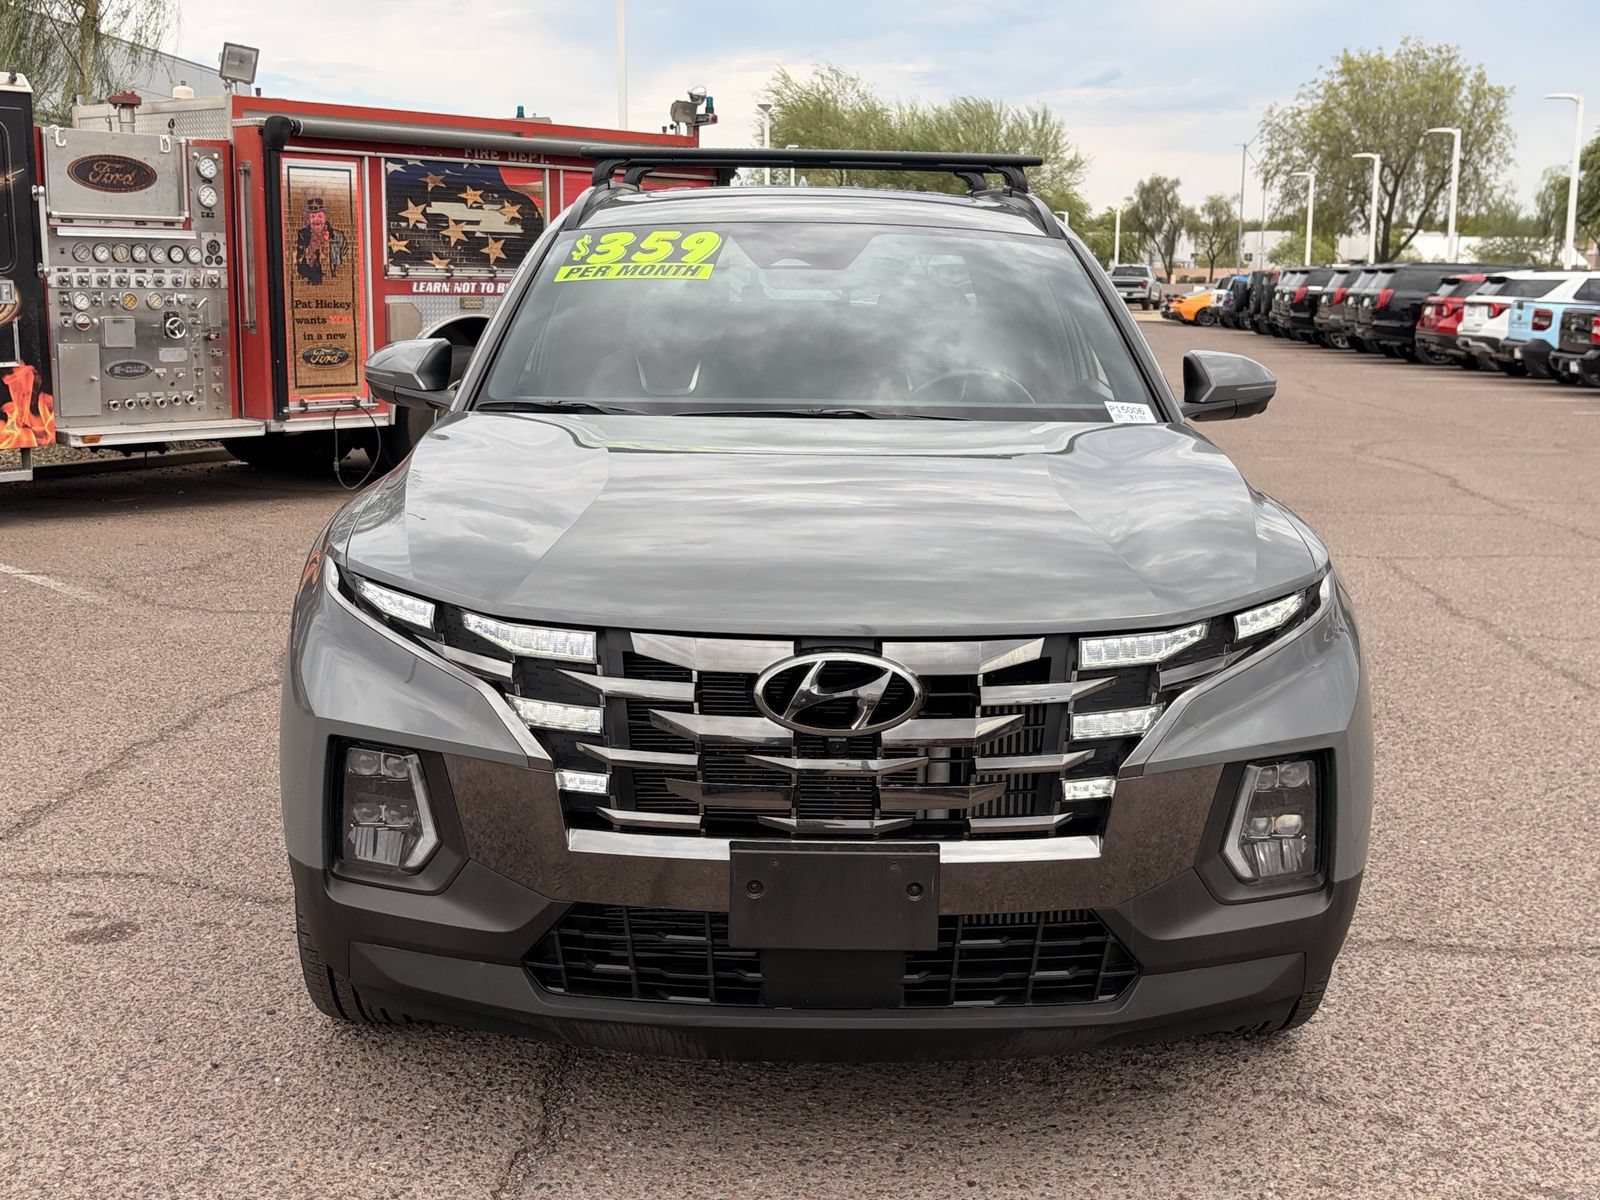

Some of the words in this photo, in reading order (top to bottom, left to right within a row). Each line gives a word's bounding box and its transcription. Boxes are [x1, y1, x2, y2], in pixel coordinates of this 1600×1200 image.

[464, 147, 500, 160] FIRE
[88, 161, 137, 185] Ford
[571, 230, 723, 264] $359
[564, 265, 611, 279] PER
[616, 264, 701, 277] MONTH
[412, 281, 450, 293] LEARN
[453, 282, 478, 294] NOT
[480, 282, 496, 294] TO
[294, 299, 313, 309] Pat
[315, 299, 352, 311] Hickey
[295, 315, 328, 325] wants
[303, 332, 314, 340] in
[310, 348, 346, 363] Ford
